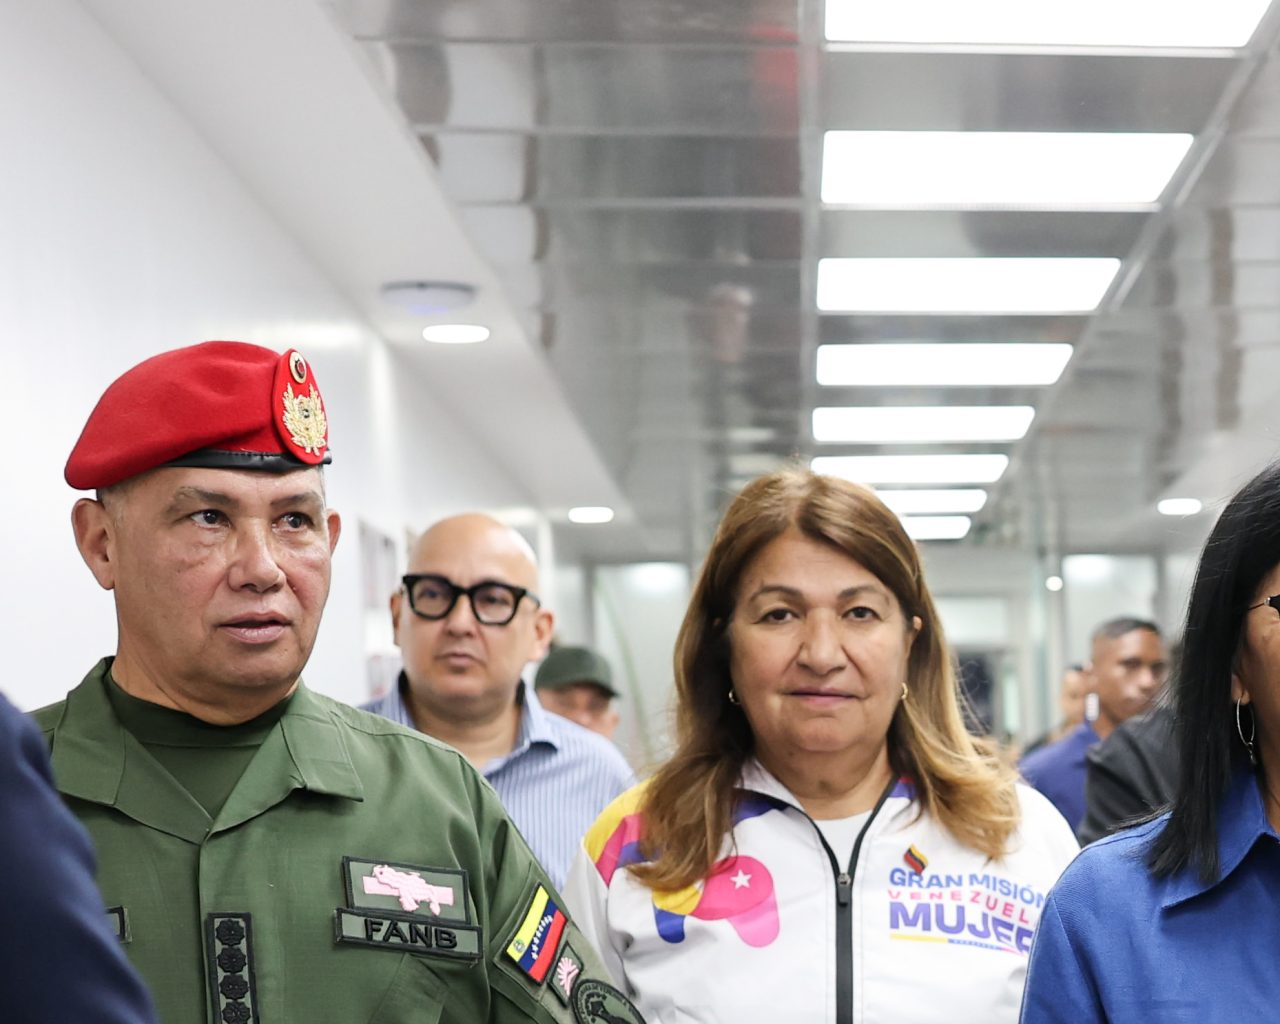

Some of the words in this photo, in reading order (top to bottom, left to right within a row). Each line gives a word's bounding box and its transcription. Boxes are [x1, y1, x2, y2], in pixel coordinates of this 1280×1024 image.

[889, 867, 963, 889] GRAN
[888, 889, 1037, 925] VENEZUEL
[364, 918, 457, 949] FANB
